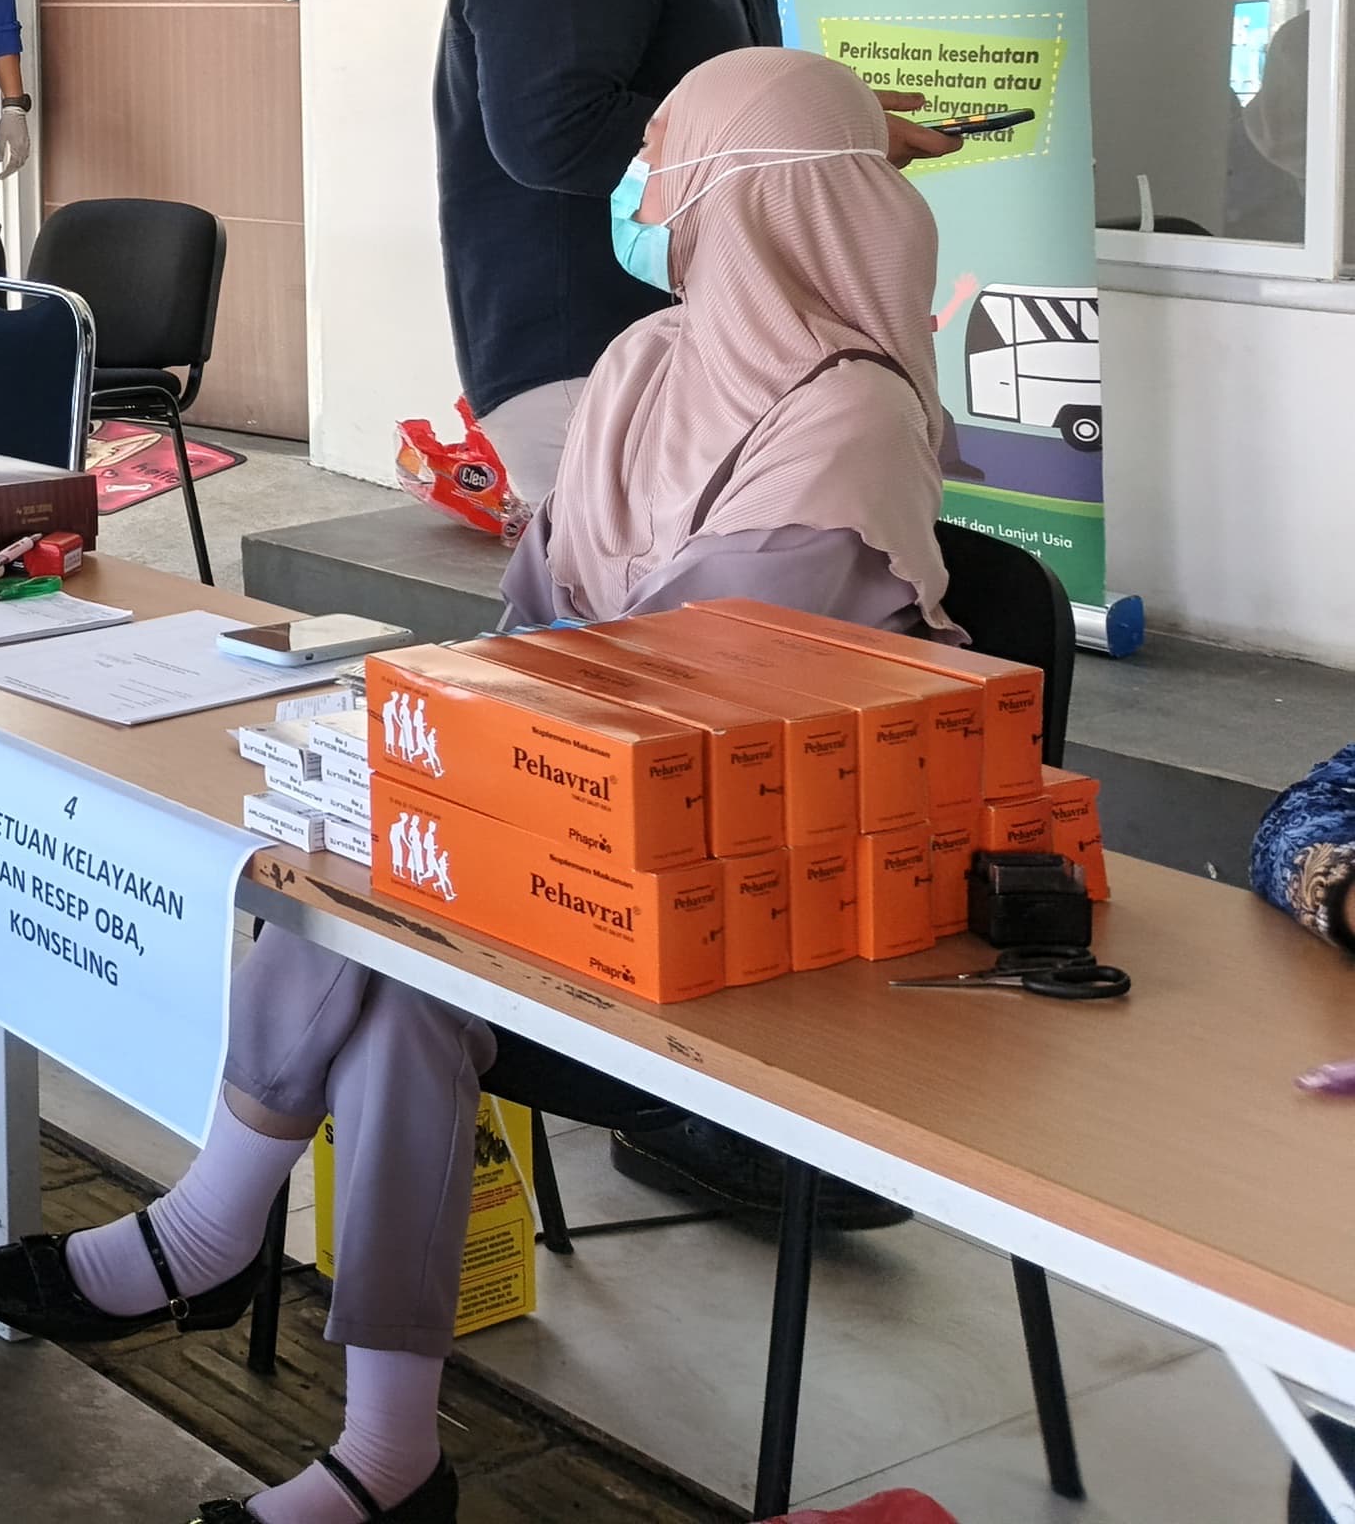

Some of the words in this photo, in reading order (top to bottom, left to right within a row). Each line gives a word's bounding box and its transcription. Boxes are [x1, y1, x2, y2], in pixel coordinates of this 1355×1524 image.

[839, 41, 932, 61] Periksakan
[938, 43, 1039, 64] kesehatan
[896, 68, 986, 89] kesehatan
[993, 75, 1042, 90] atau
[970, 519, 994, 535] dan
[998, 524, 1039, 543] Lanjut
[1042, 532, 1073, 548] Usia
[512, 746, 611, 801] Pehavral
[63, 795, 79, 821] 4
[62, 842, 184, 921] KELAYAKAN
[530, 872, 634, 931] Pehavral
[32, 870, 89, 923] RESEP
[96, 906, 145, 956] OBA,
[9, 908, 119, 987] KONSELING
